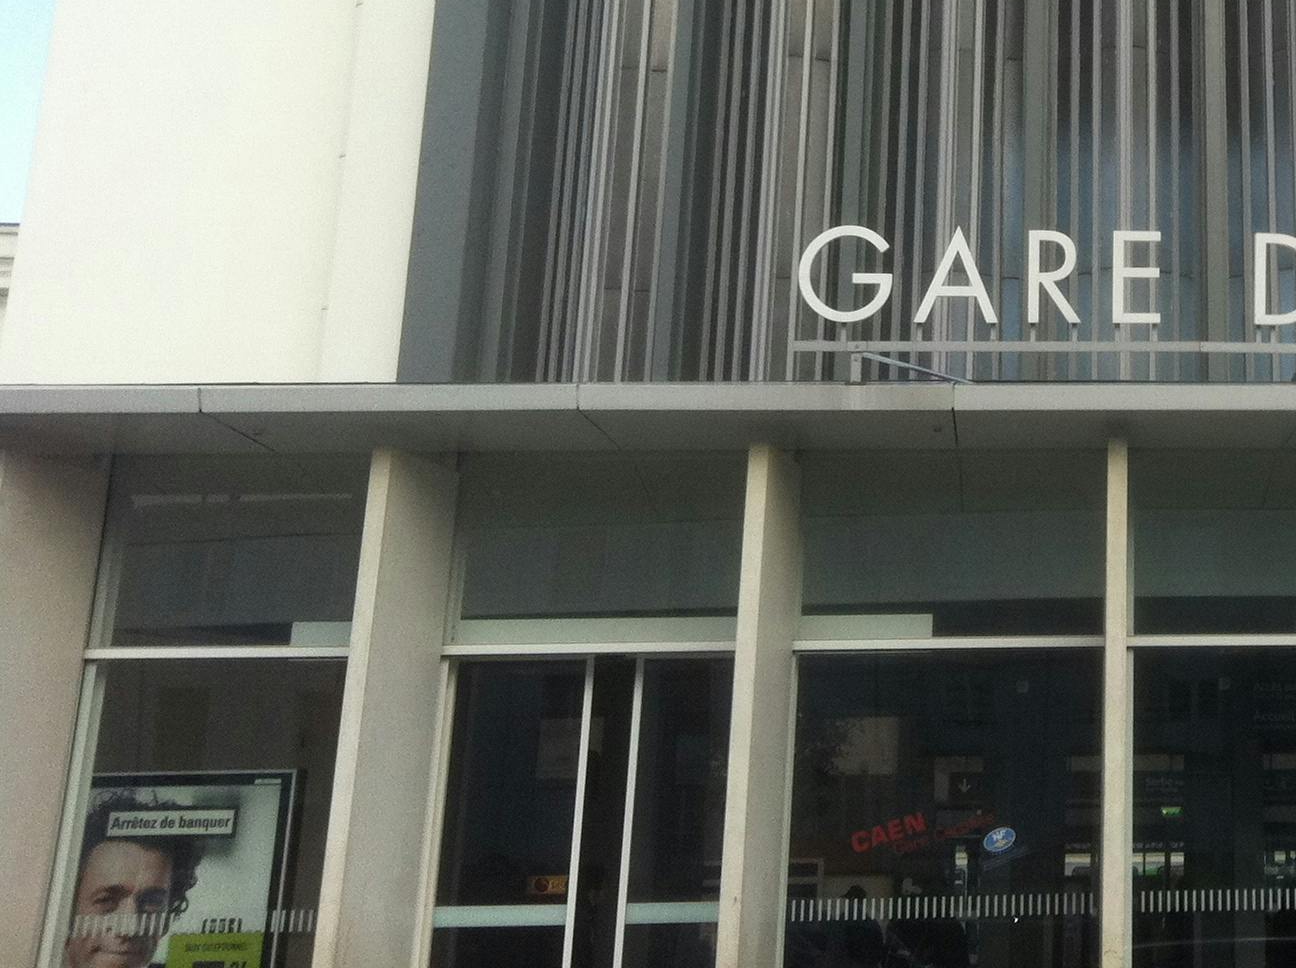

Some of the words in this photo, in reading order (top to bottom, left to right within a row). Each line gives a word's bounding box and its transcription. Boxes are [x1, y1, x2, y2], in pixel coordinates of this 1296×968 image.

[799, 225, 1161, 323] GARE
[110, 815, 158, 830] Arrêtez
[160, 816, 175, 829] de
[178, 816, 231, 831] banquer
[851, 812, 927, 853] CAEN
